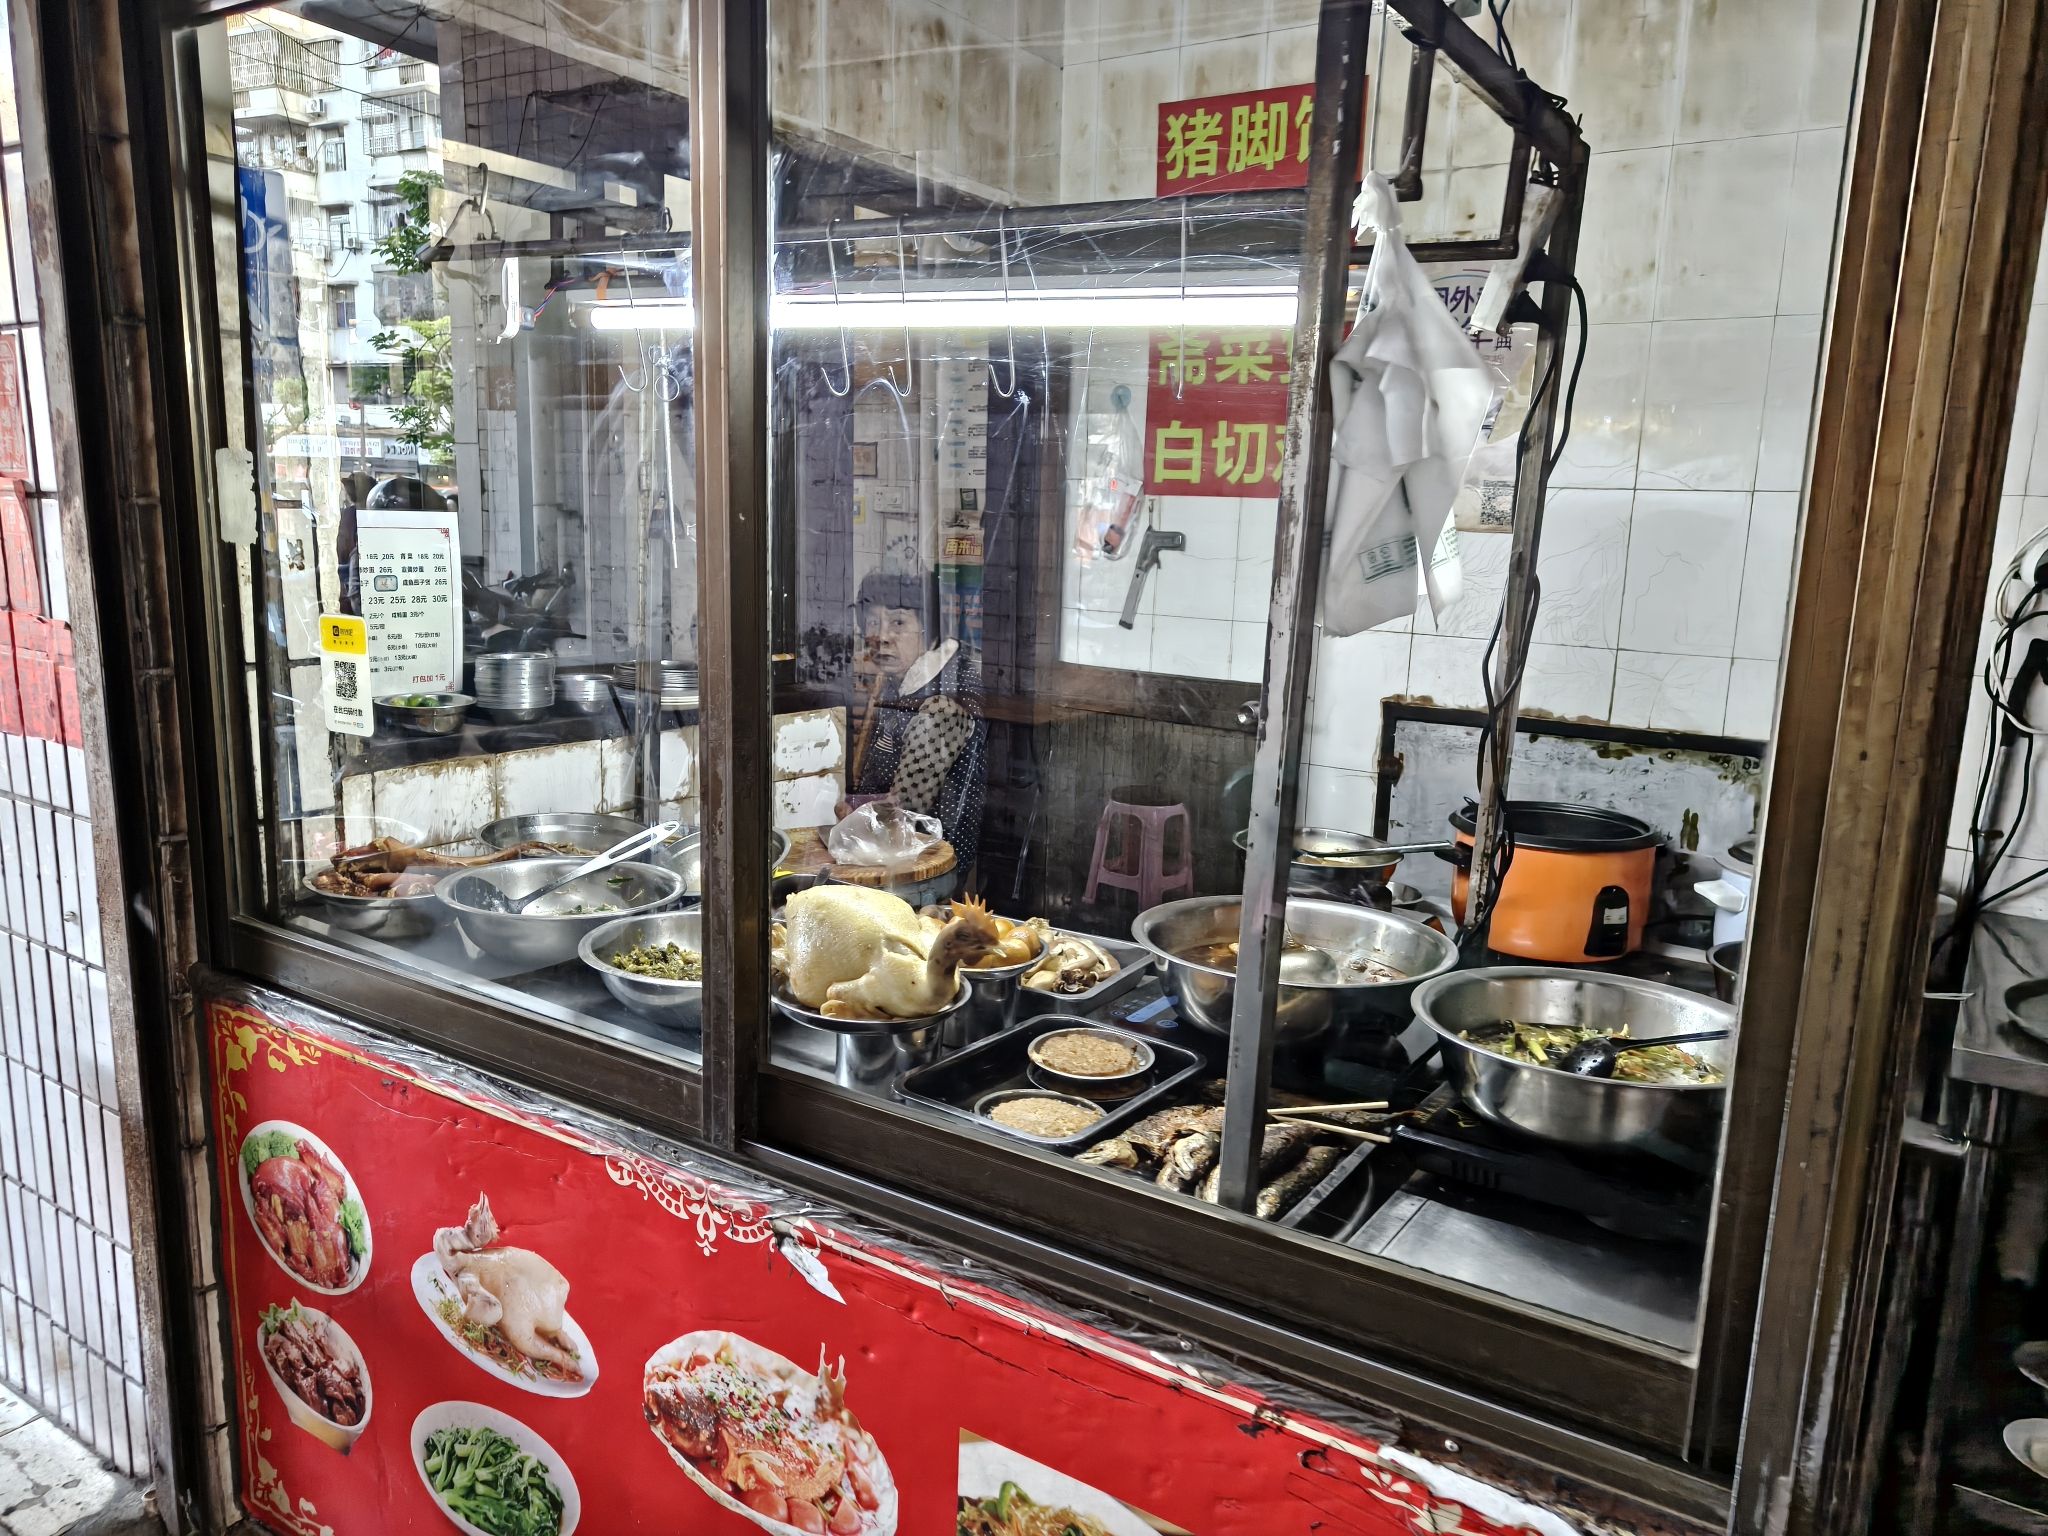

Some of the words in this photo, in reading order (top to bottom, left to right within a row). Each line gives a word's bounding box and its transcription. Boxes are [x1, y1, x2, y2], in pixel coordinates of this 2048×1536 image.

[1156, 326, 1293, 385] 斋菜
[368, 596, 385, 605] 23元
[390, 596, 407, 604] 25元
[411, 595, 428, 604] 28元
[432, 594, 448, 603] 30元
